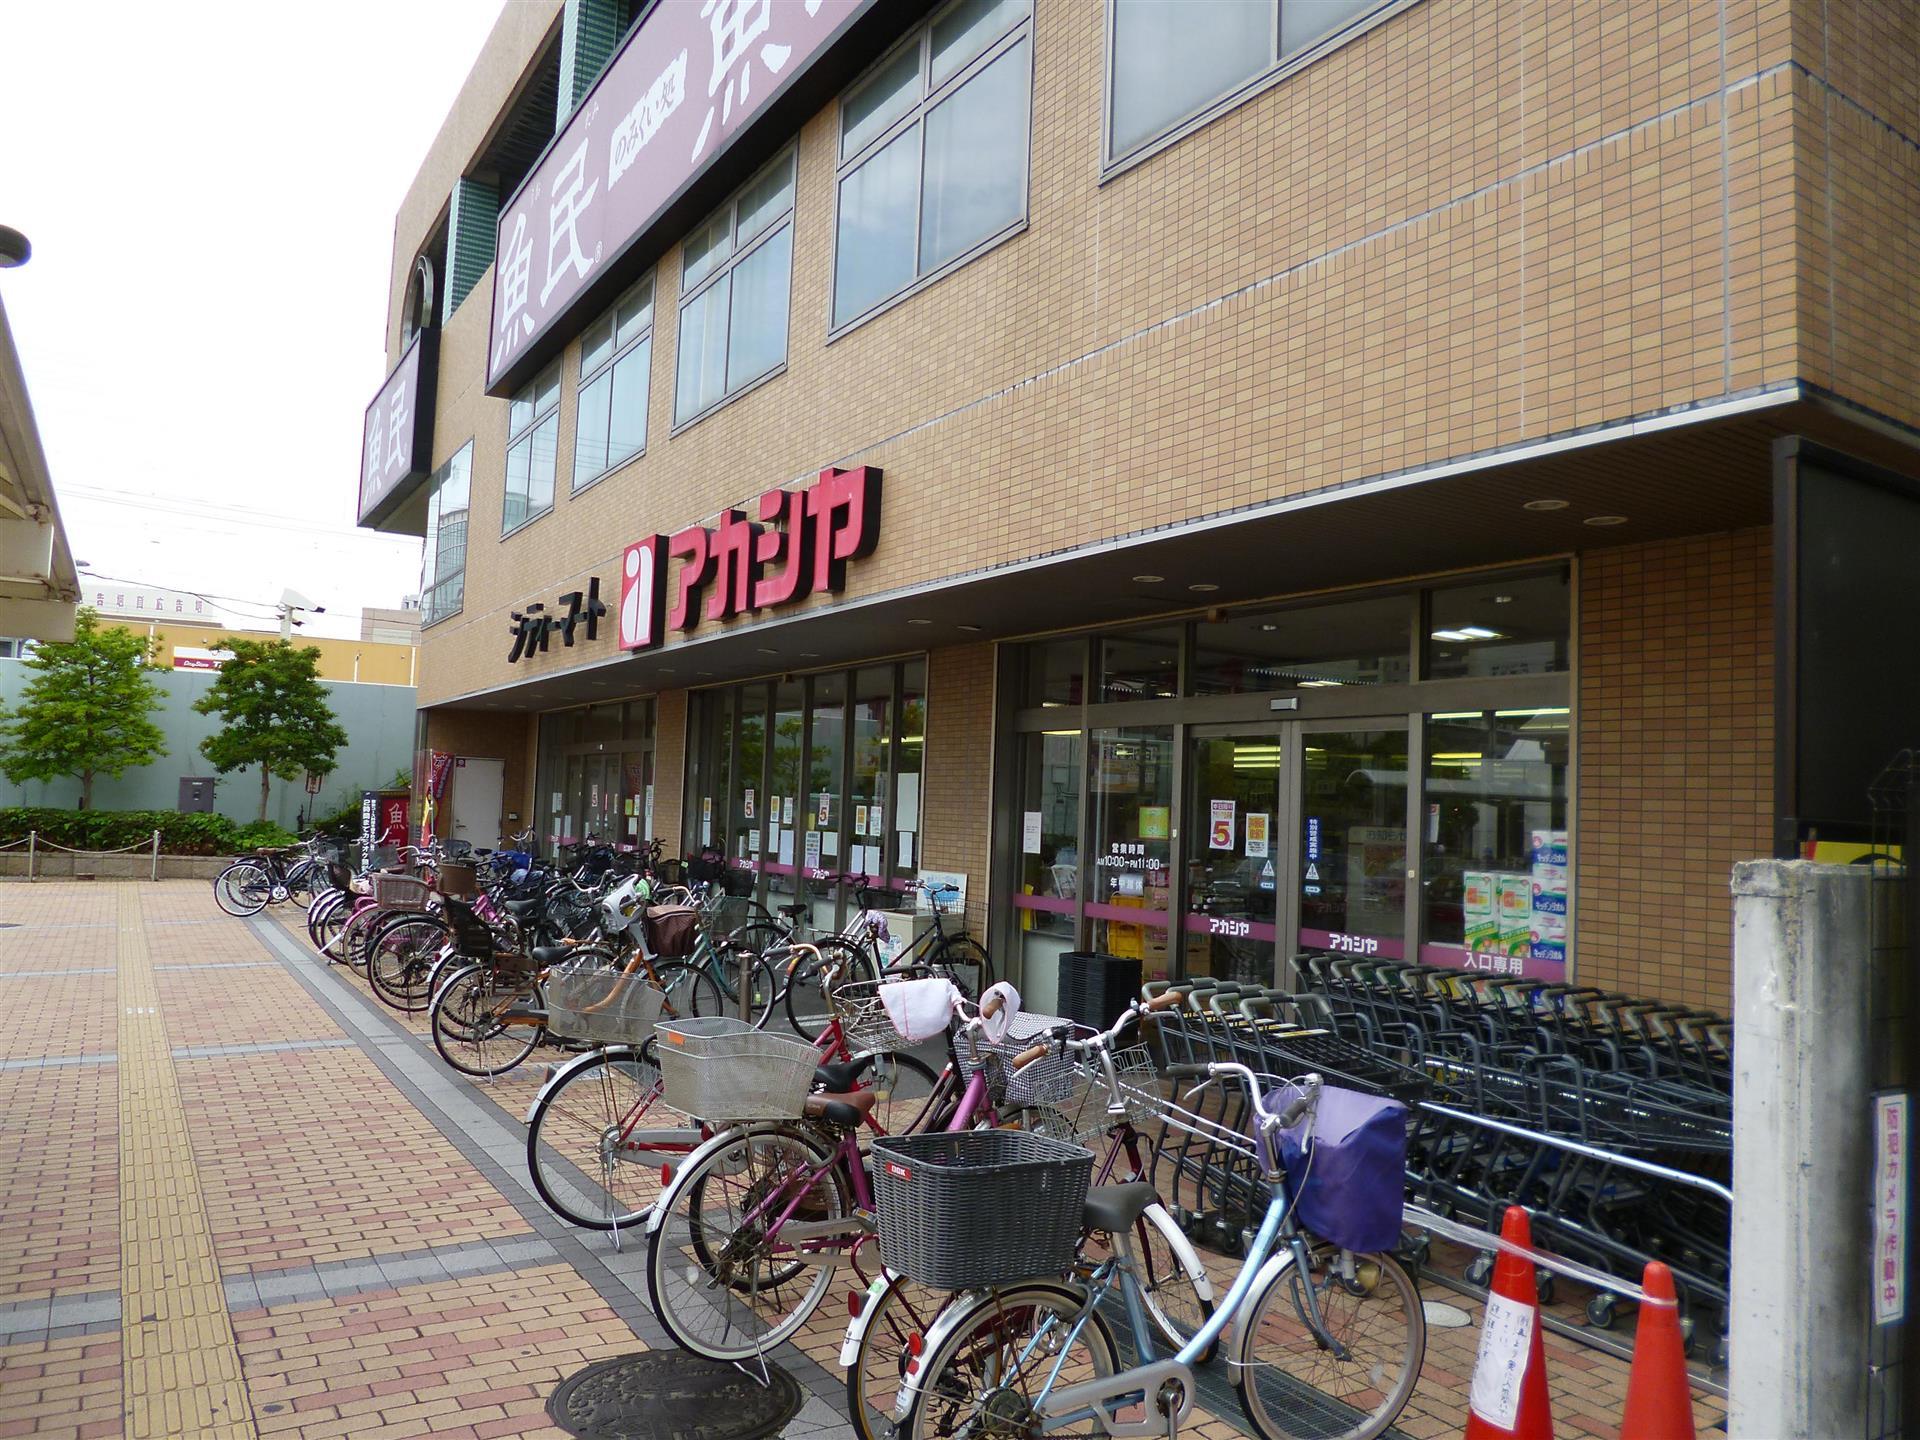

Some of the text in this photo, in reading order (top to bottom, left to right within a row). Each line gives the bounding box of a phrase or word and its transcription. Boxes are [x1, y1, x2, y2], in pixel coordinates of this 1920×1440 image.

[494, 138, 600, 372] 魚民
[364, 380, 409, 506] 魚民
[669, 465, 880, 632] アカシヤ
[1212, 821, 1230, 847] 5
[1112, 843, 1145, 855] 営業時間
[1209, 918, 1250, 936] アカシヤ
[1329, 933, 1378, 954] アカシヤ
[1463, 952, 1523, 975] 入口専用
